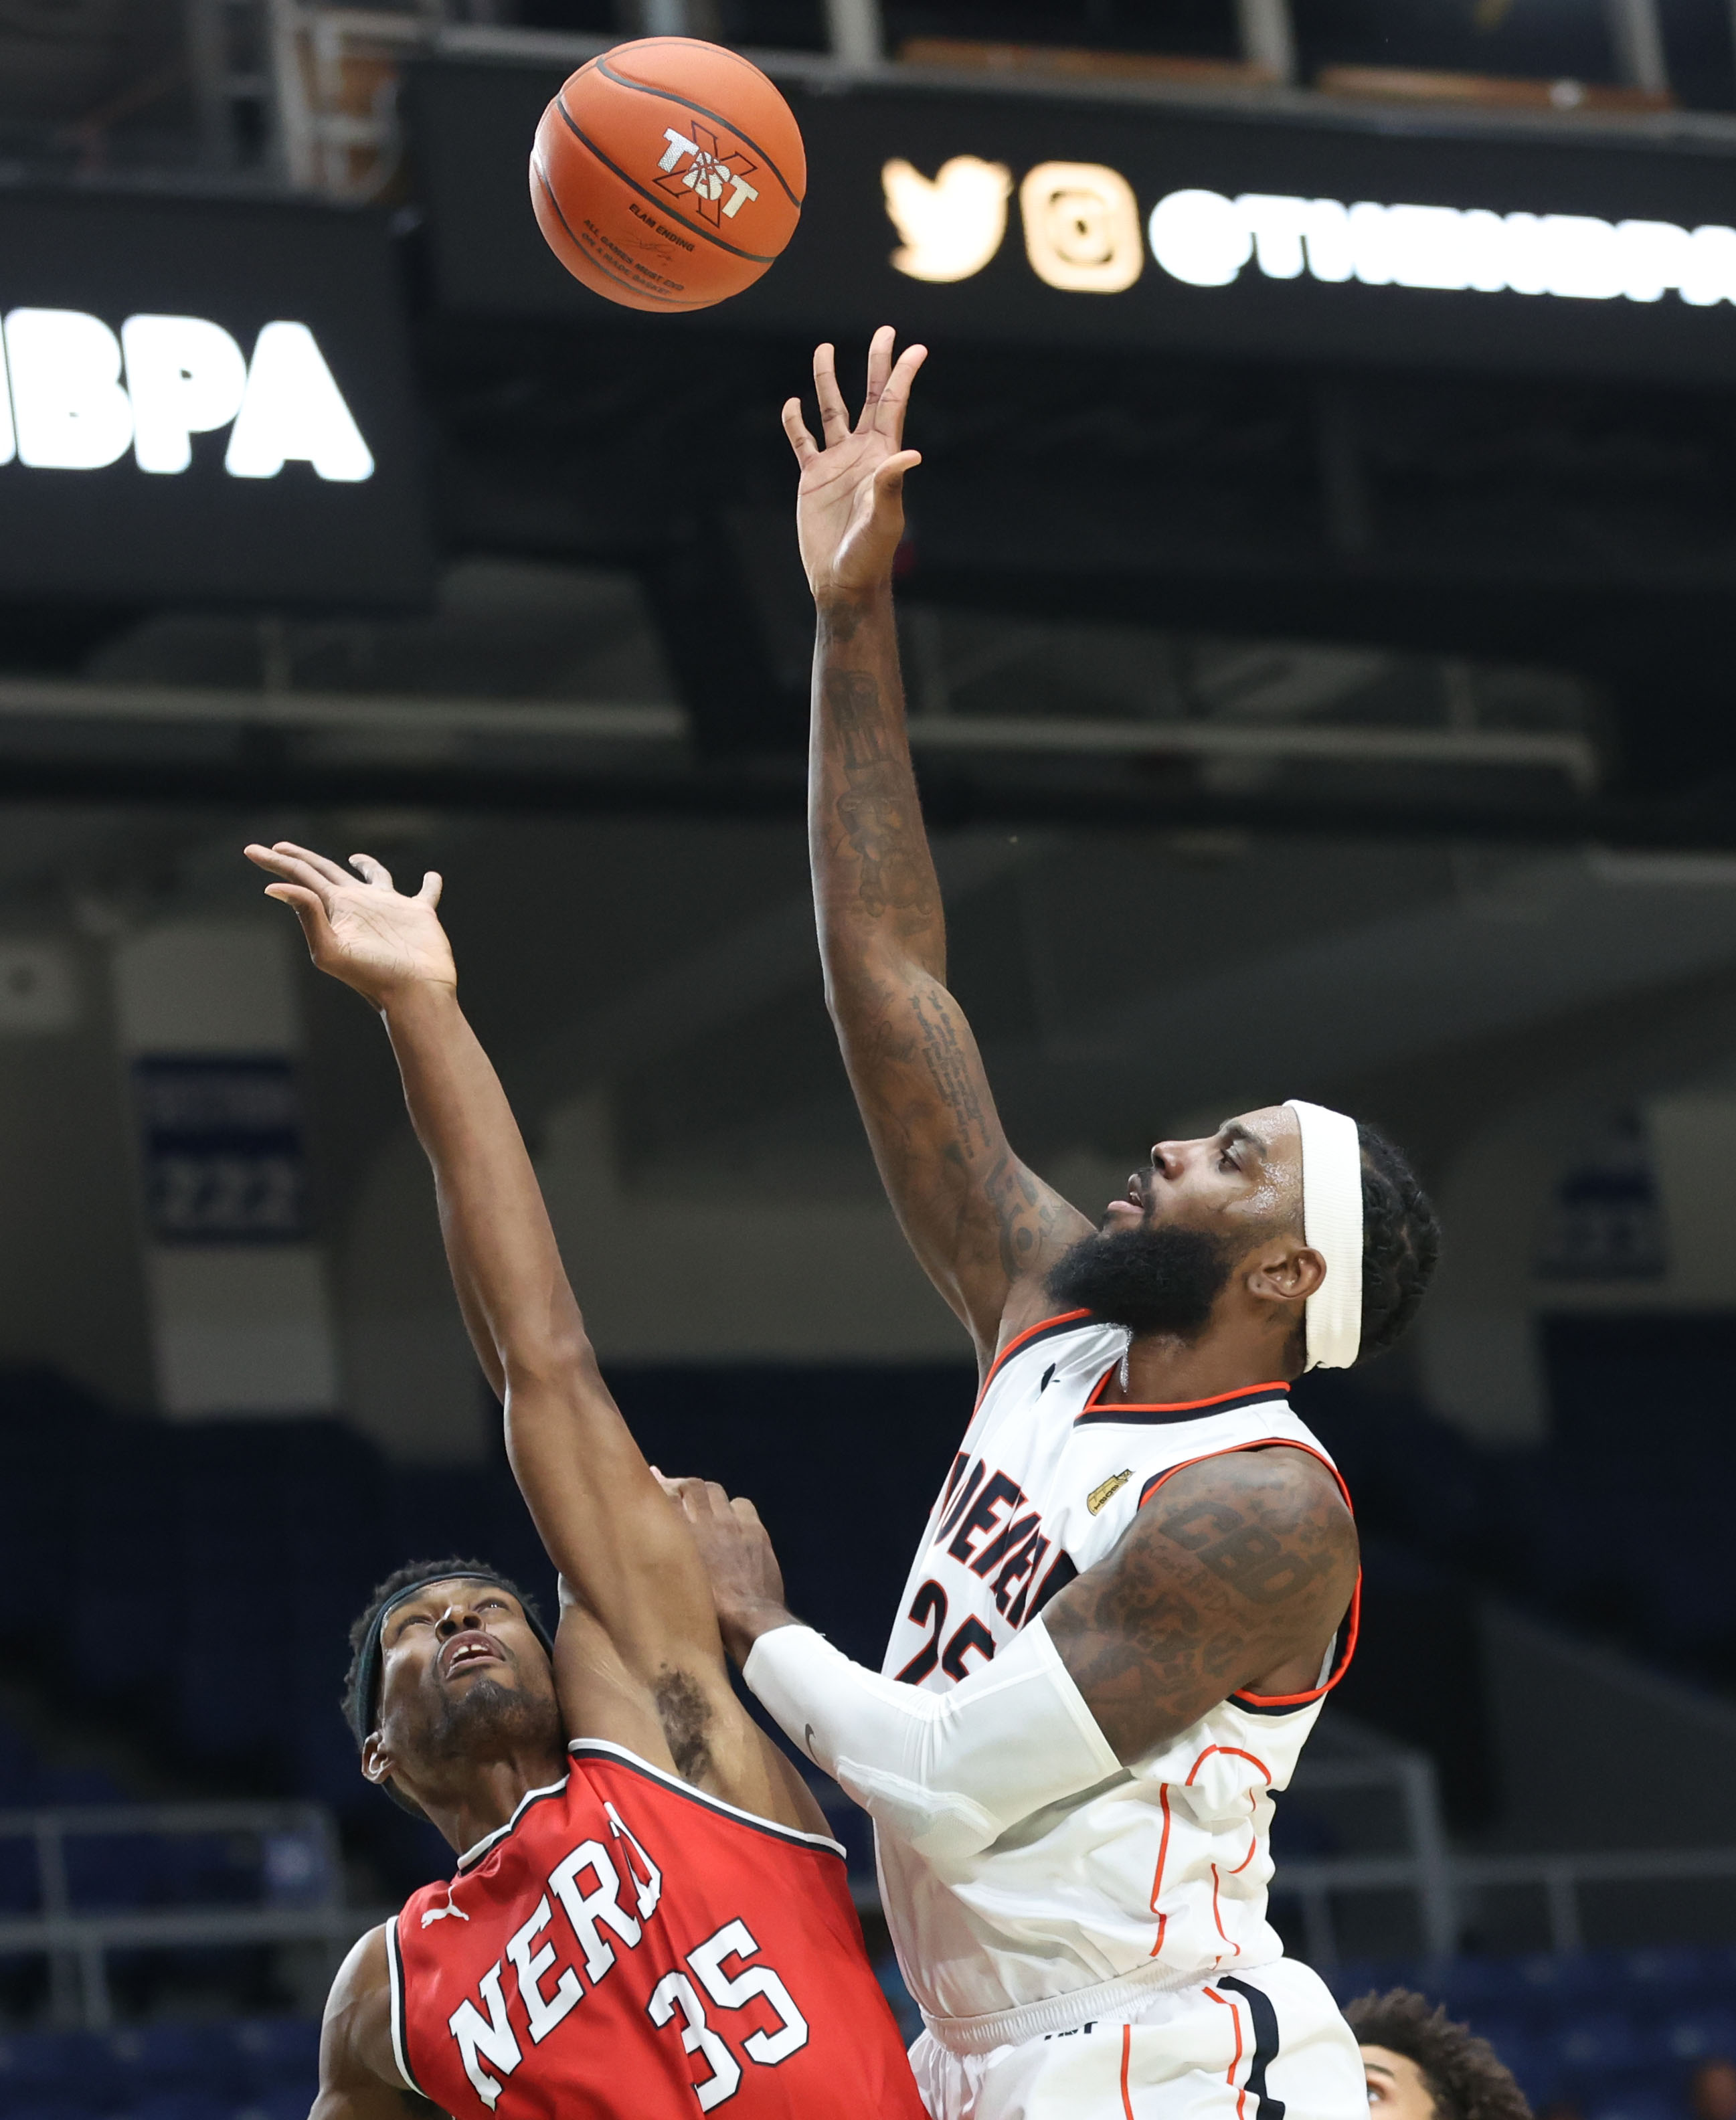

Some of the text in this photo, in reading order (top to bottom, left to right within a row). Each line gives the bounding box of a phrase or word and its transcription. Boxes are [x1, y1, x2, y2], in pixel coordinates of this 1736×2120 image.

[658, 127, 759, 219] TBT
[584, 219, 600, 236] ALL
[600, 236, 634, 264] GAMES
[635, 263, 664, 281] MUST
[628, 203, 657, 228] ELAM
[655, 225, 695, 252] ENDING
[0, 306, 375, 482] BPA
[646, 1916, 810, 2114] 35
